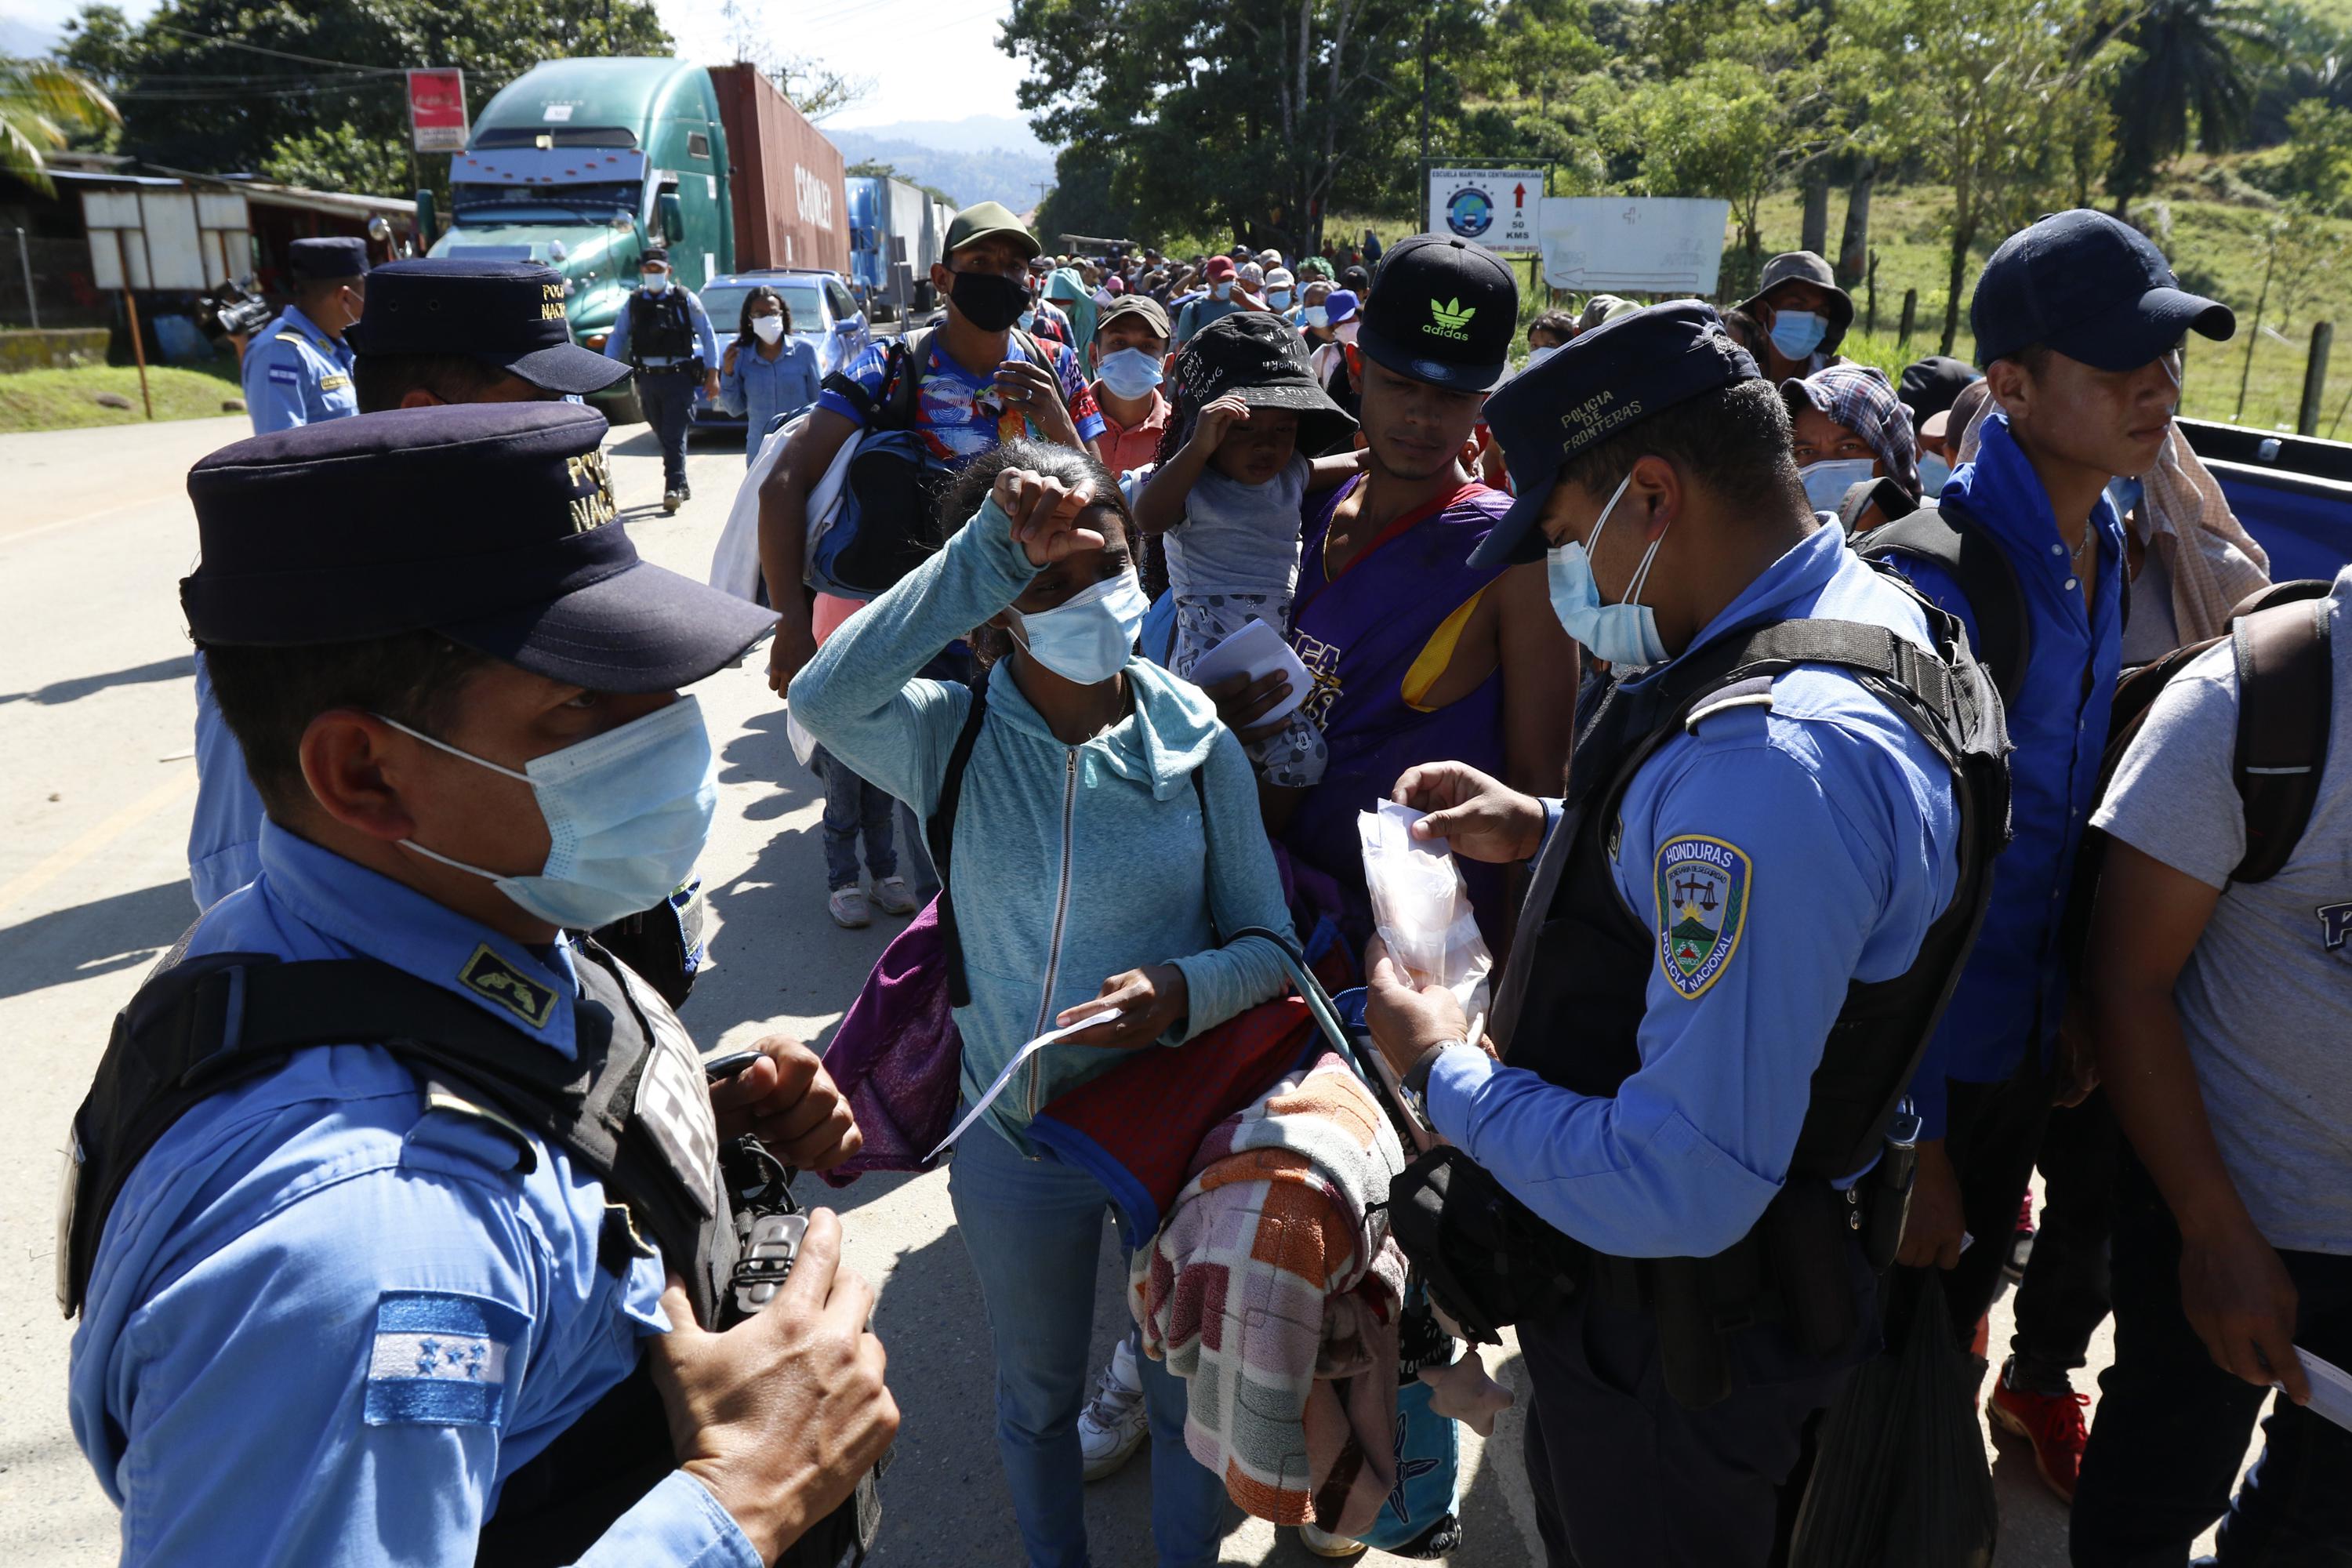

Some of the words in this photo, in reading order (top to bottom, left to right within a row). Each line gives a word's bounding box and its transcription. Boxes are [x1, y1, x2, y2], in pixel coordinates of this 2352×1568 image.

[1488, 169, 1542, 178] CENTROAMERICANA
[1422, 325, 1469, 341] adidas
[1279, 339, 1298, 355] WTF
[1193, 366, 1223, 402] YOUNG
[1561, 390, 1614, 429] POLICIA
[1582, 408, 1602, 427] DE
[1563, 401, 1642, 454] FRONTERAS
[1665, 842, 1734, 869] HONDURAS
[1661, 931, 1686, 992] POLICIA
[1689, 935, 1733, 992] NACIONAL
